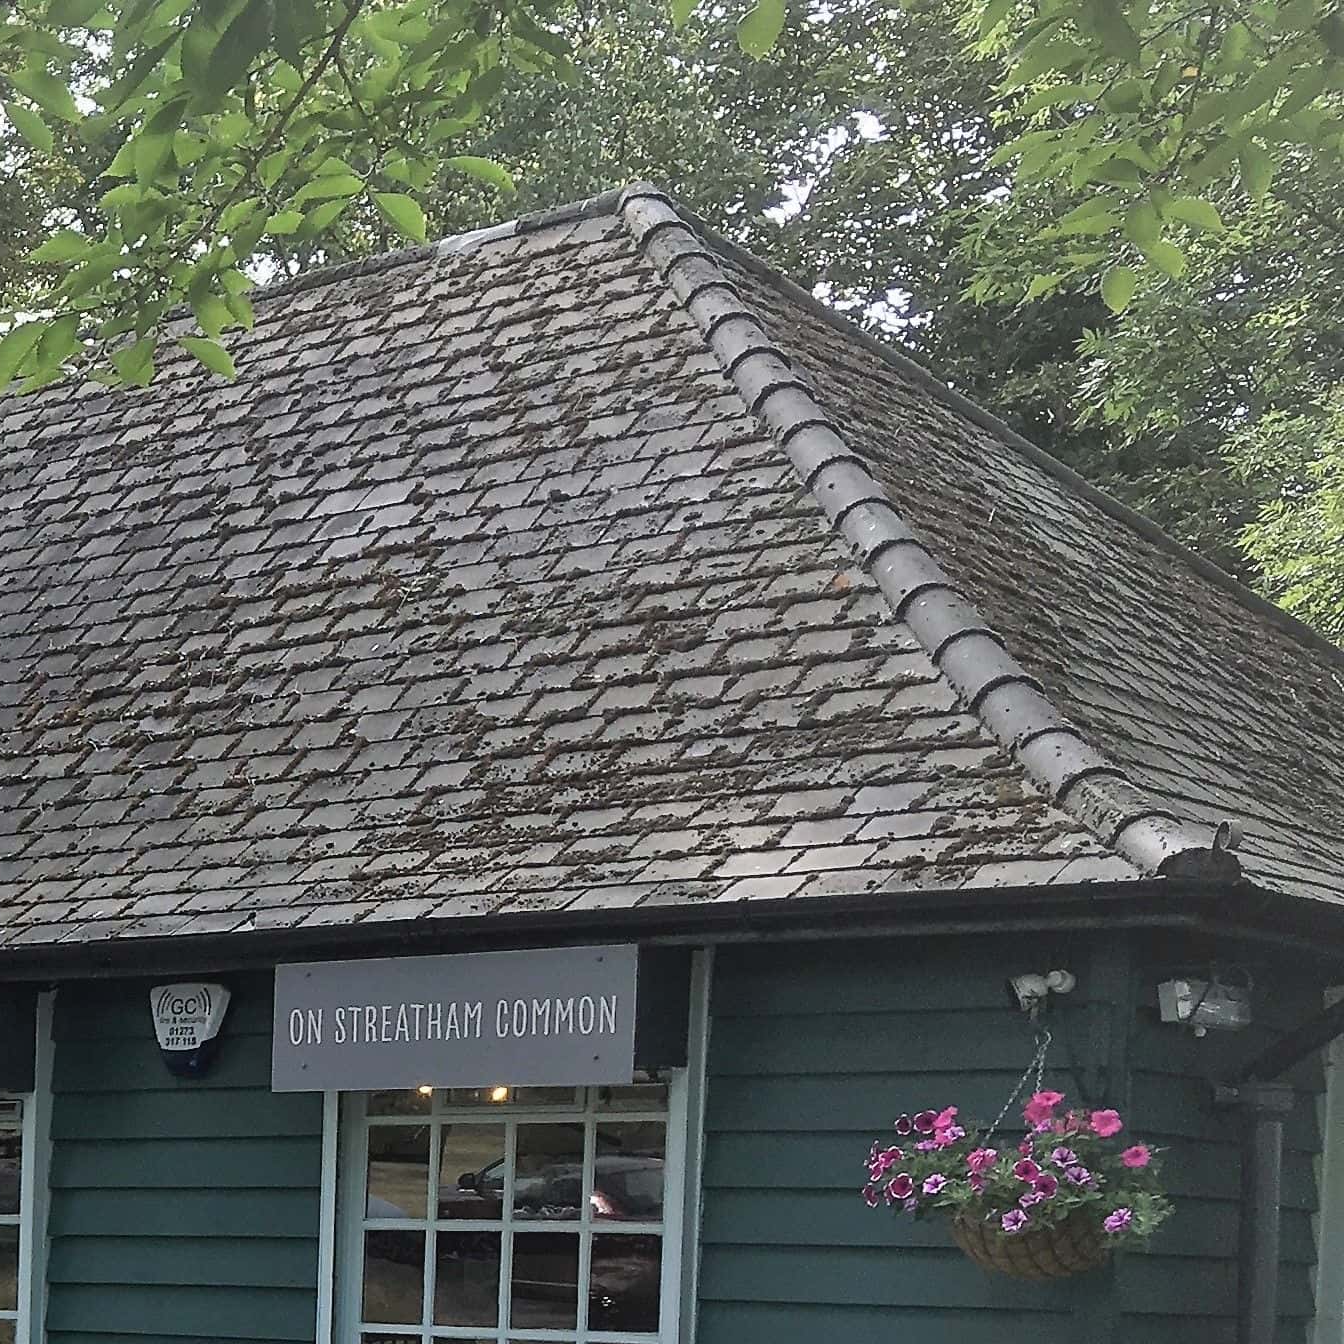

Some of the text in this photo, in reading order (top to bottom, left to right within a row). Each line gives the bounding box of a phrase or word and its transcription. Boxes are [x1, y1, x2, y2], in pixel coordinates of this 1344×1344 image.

[171, 998, 197, 1015] GC
[289, 995, 617, 1045] ON STREATHAM COMMON
